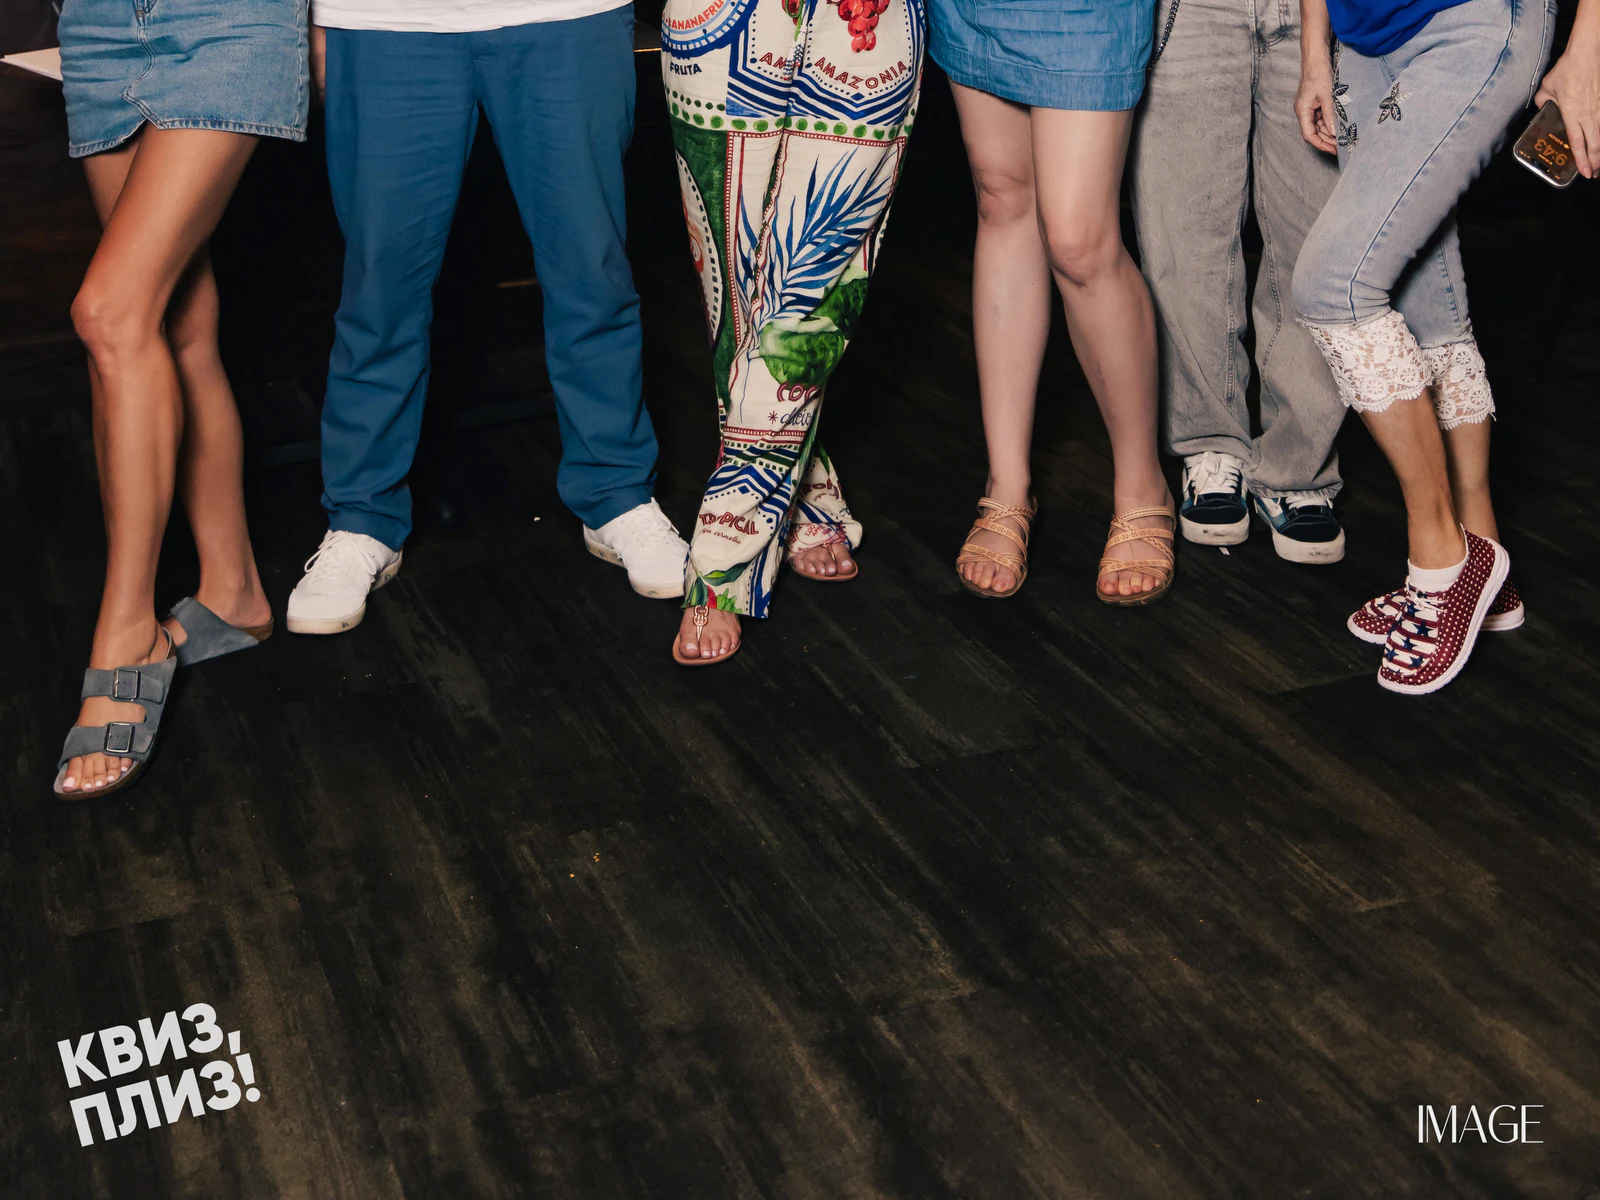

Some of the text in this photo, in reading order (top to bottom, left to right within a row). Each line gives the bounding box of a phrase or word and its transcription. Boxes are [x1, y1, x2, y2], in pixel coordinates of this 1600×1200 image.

[669, 61, 702, 75] FRUTA
[814, 57, 907, 89] AMAZONIA
[1534, 138, 1568, 166] 9:43
[699, 512, 759, 534] TRPICAL
